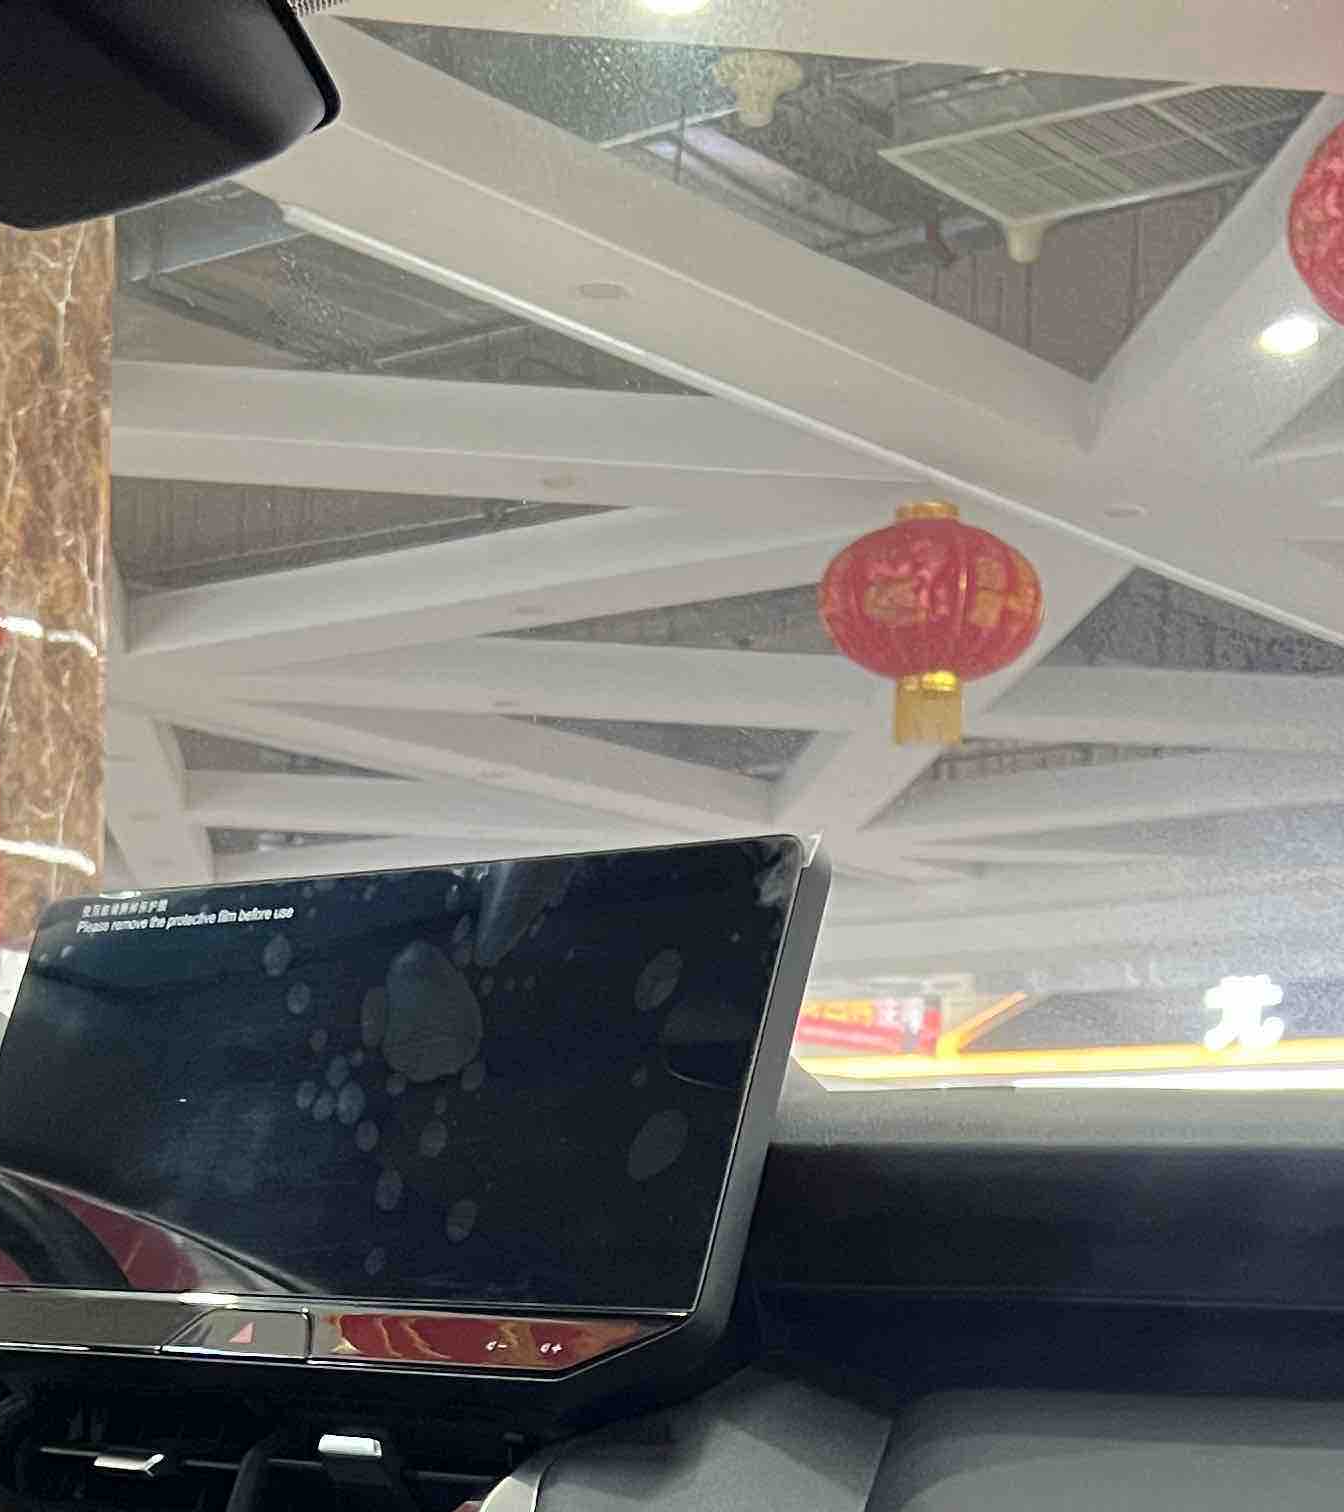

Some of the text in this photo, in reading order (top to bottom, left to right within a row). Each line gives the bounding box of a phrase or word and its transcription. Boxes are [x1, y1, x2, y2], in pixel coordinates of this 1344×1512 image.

[76, 906, 294, 933] Please remove the protective film before use
